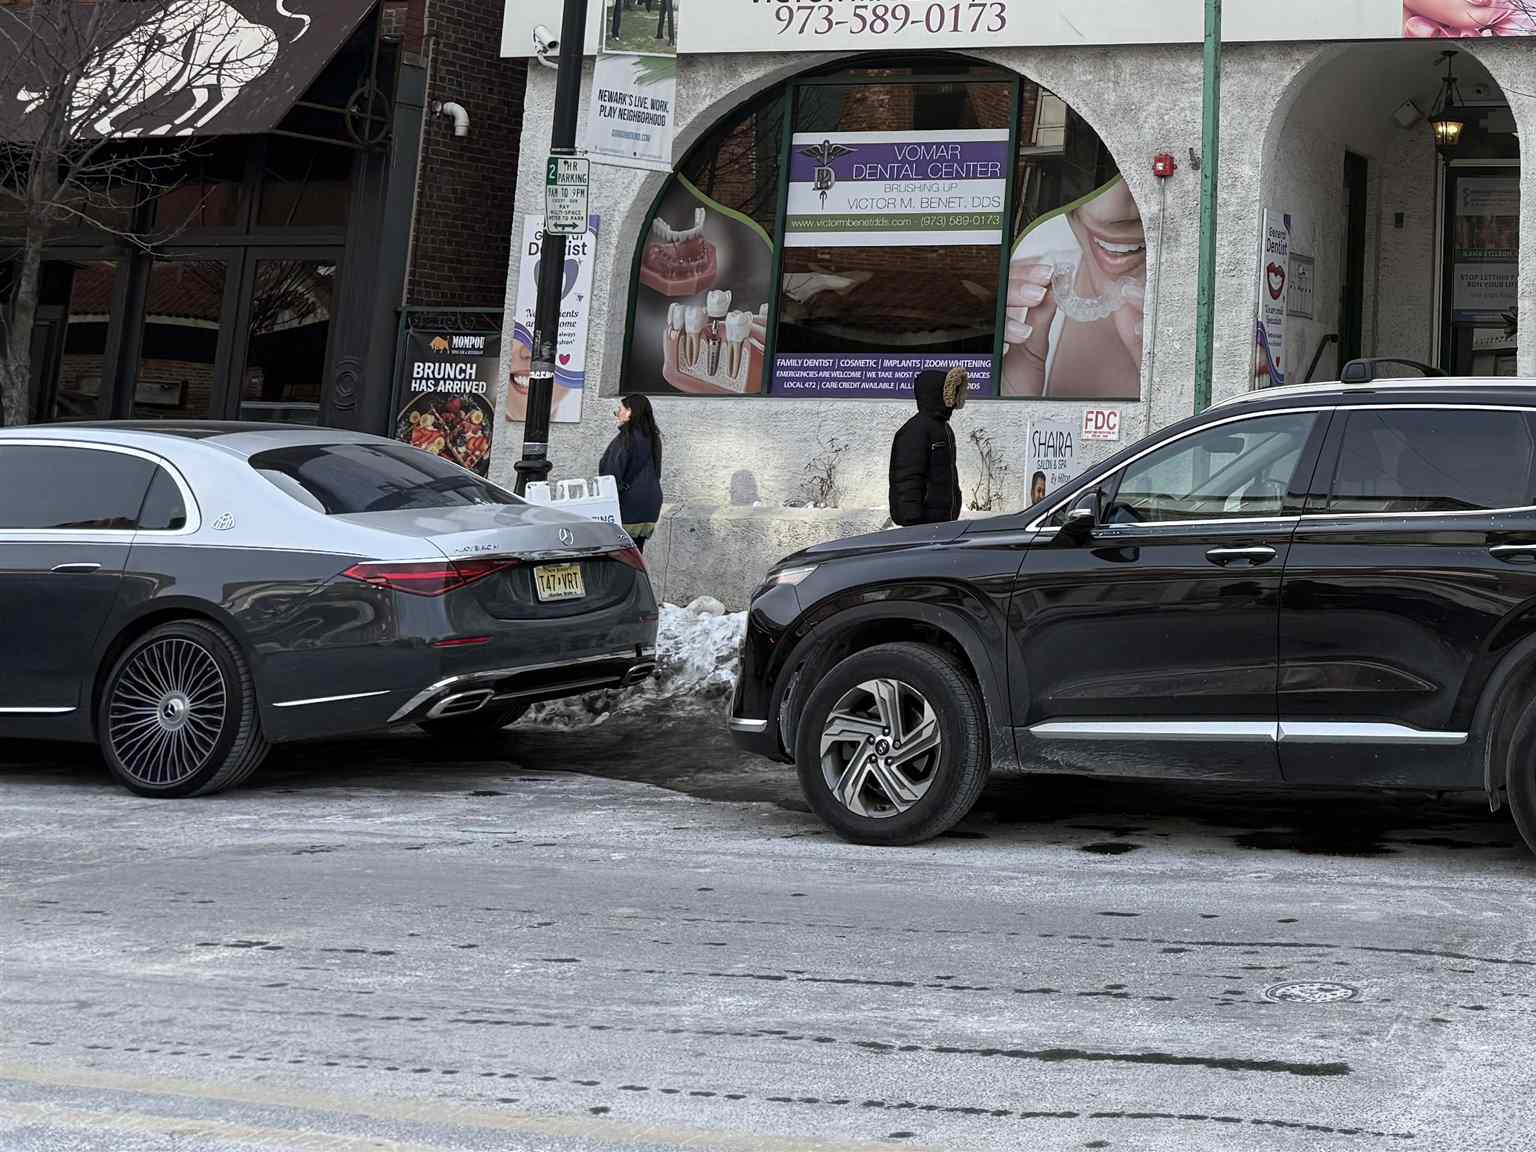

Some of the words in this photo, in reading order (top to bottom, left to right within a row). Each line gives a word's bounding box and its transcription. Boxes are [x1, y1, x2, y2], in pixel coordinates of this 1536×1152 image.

[775, 2, 1007, 35] 973-589-0173
[598, 88, 633, 107] NEWARK'S
[599, 104, 617, 119] PLAY
[618, 107, 666, 127] NEIGHBORHOOD
[893, 144, 961, 161] VOMAR
[549, 163, 556, 179] 2
[558, 173, 587, 184] PARKING
[852, 162, 924, 181] DENTAL
[927, 161, 1001, 179] CENTER
[883, 183, 940, 194] BRUSHING
[848, 197, 897, 210] VICTOR
[970, 195, 1001, 208] DDS
[452, 335, 486, 349] MOMPOU
[776, 358, 803, 367] FAMILY
[803, 358, 834, 367] DENTIST
[839, 358, 877, 368] COSMETIC
[883, 359, 921, 368] IMPLANTS
[924, 359, 947, 368] ZOOM
[948, 359, 992, 368] WHITENING
[412, 362, 477, 380] BRUNCH
[831, 370, 861, 378] WELCOME
[411, 379, 435, 393] HAS
[436, 380, 487, 394] ARRIVED
[783, 381, 804, 389] LOCAL
[861, 381, 895, 389] AVAILABLE
[1085, 410, 1118, 431] FDC
[1032, 430, 1073, 458] SHAIRA
